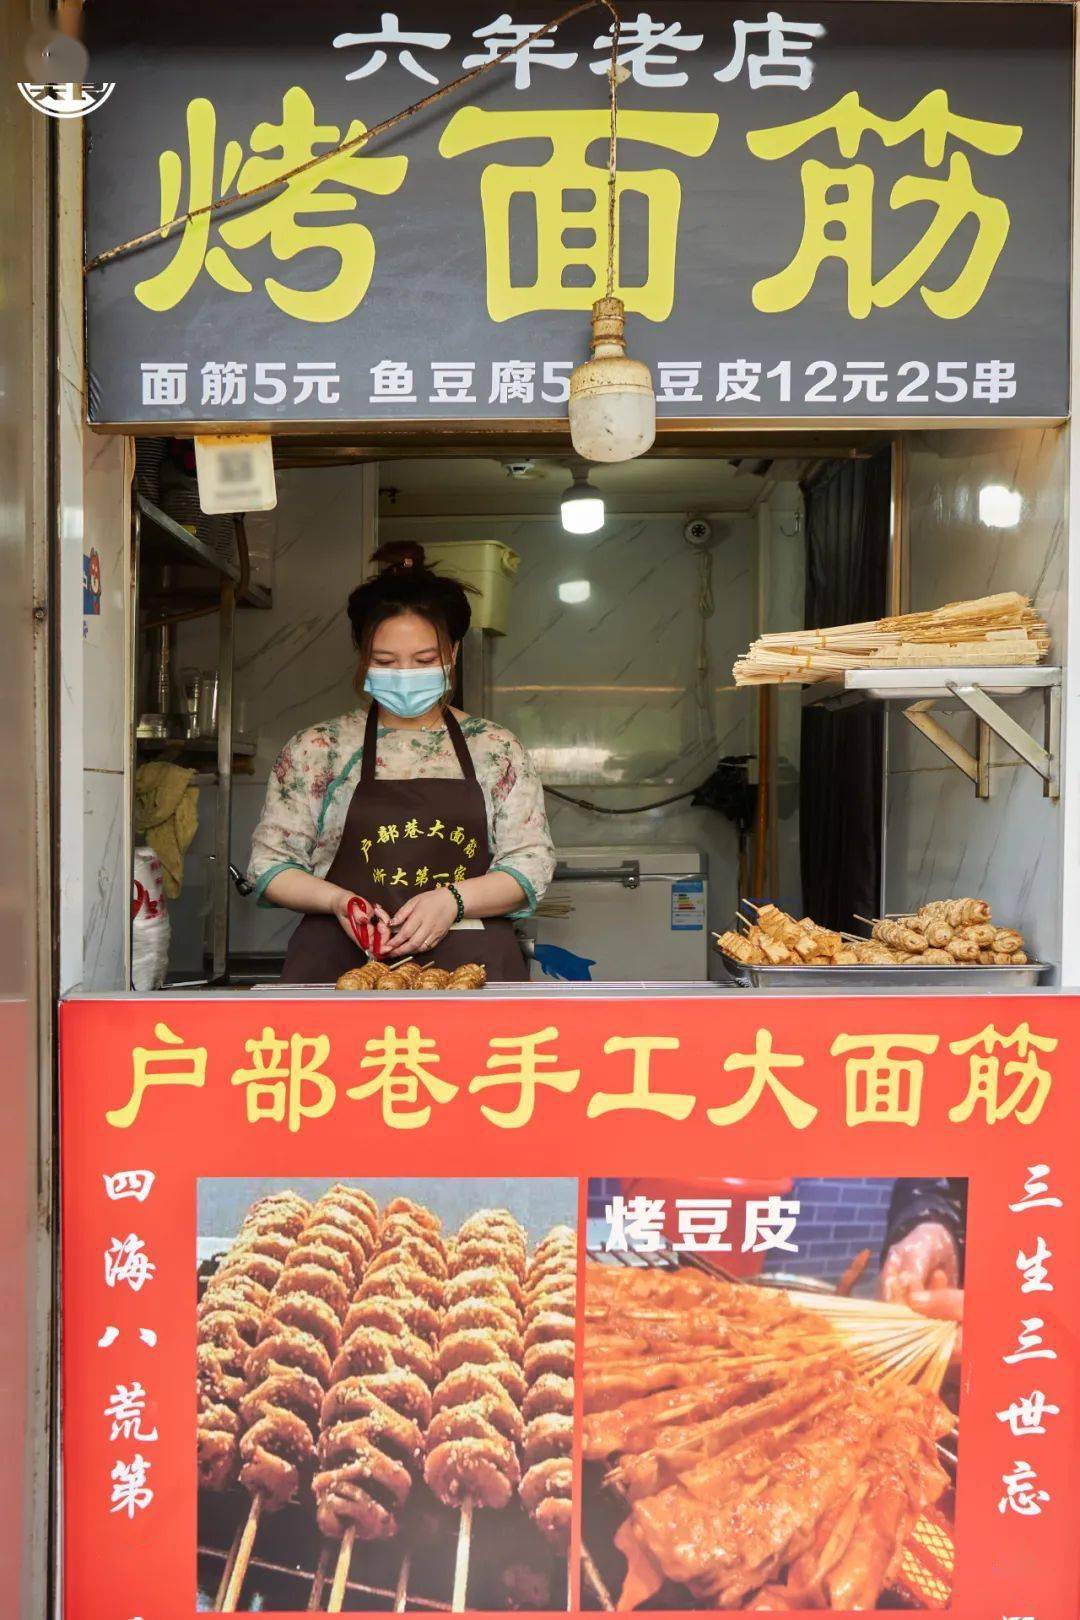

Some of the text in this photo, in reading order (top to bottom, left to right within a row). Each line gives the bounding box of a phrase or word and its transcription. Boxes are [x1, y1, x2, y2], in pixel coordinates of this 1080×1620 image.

[332, 12, 826, 91] 六年老店
[134, 86, 1024, 322] 烤面筋
[140, 358, 1018, 406] 面筋5元 鱼豆腐5 豆皮12元25串
[105, 1021, 1060, 1132] 户部巷手工大面筋
[604, 1196, 801, 1253] 烤豆皮
[98, 1168, 159, 1620] 四海八荒第
[995, 1163, 1064, 1620] 三生三世忘
